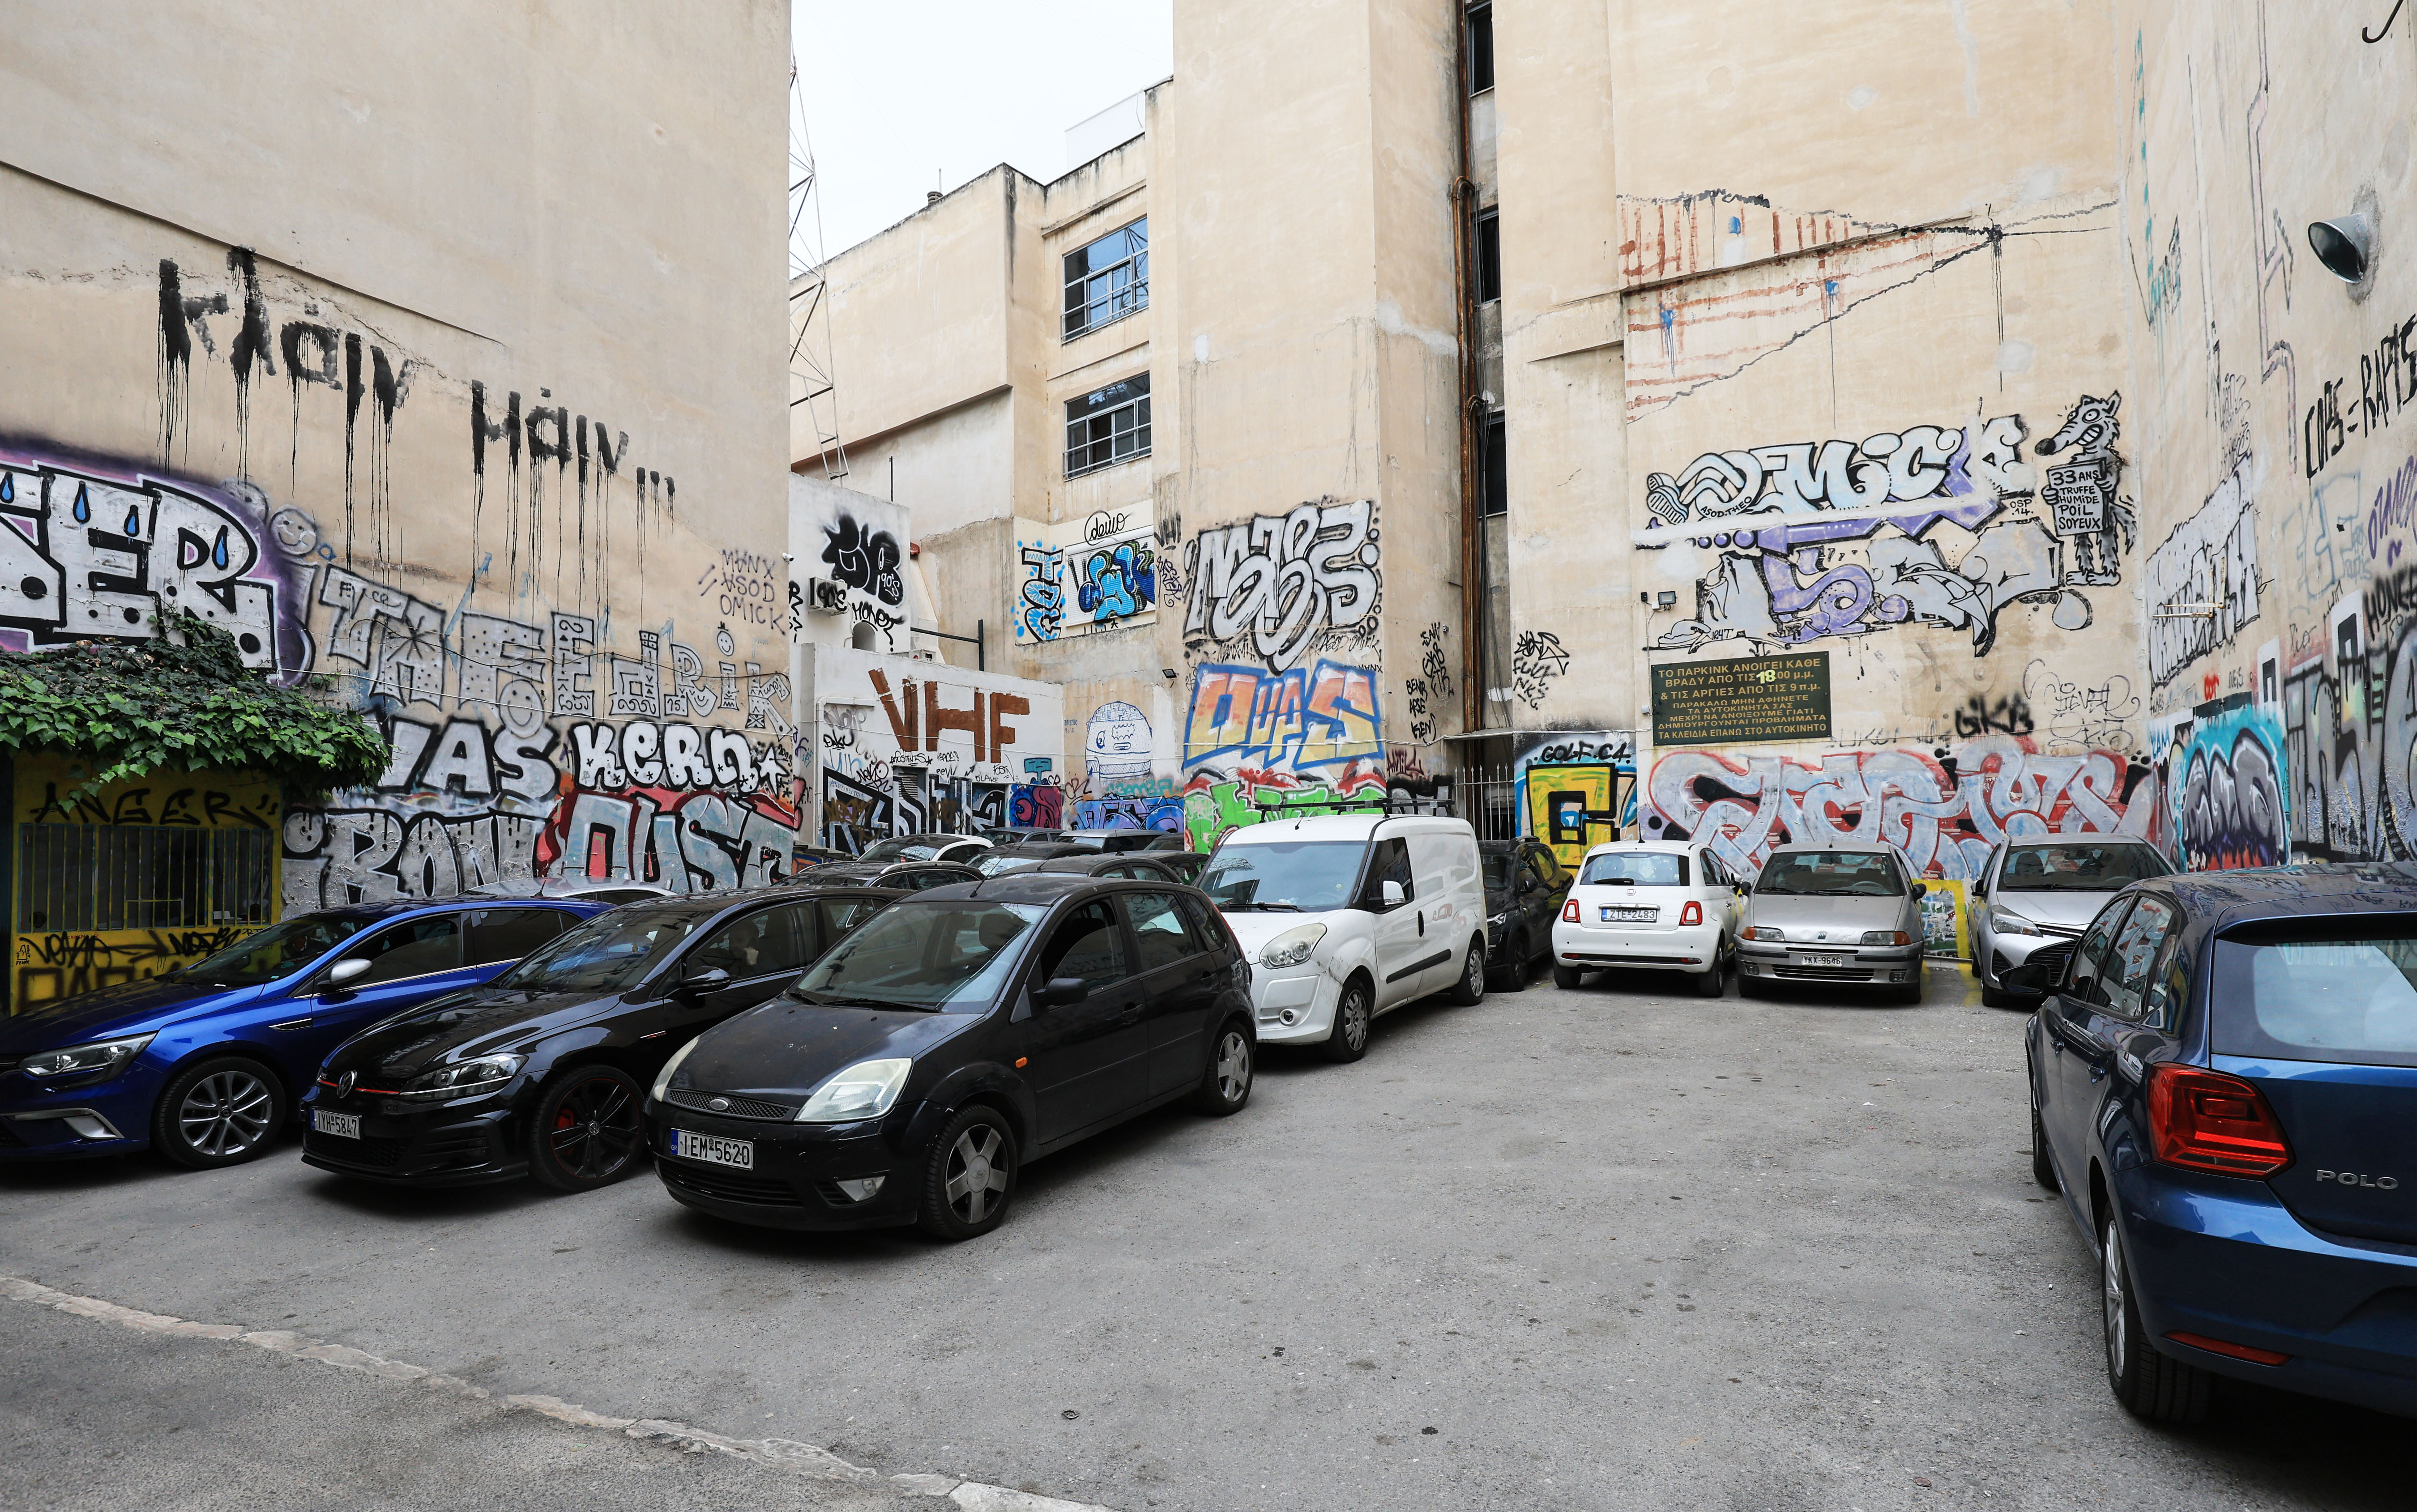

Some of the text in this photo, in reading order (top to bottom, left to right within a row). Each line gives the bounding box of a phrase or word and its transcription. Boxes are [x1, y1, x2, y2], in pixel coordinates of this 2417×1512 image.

[2051, 470, 2099, 486] 33 ANS
[2059, 486, 2095, 495] TRUFFE
[2010, 499, 2032, 508] OSP
[2059, 517, 2101, 530] SOYEUX
[721, 594, 786, 635] OMICK
[1678, 665, 1729, 676] ΠΑΡΚΙΝΚ
[1733, 661, 1782, 672] ΑΝΟΙΓΕΙ
[1786, 658, 1820, 668] ΚΑΘΕ
[1665, 677, 1704, 687] ΒΡΑΔΥ
[1708, 675, 1733, 684] ΑΠΟ
[1737, 673, 1755, 681] ΤΙΣ
[1670, 691, 1688, 699] ΤΙΣ
[1692, 688, 1734, 698] ΑΡΓΙΕΣ
[1738, 686, 1764, 694] ΑΠΟ
[1767, 684, 1786, 692] ΤΙΣ
[1673, 700, 1728, 708] ΠΑΡΑΚΑΛΩ
[1759, 694, 1809, 703] ΑΦΗΝΕΤΕ
[868, 667, 1030, 763] VHF
[1704, 704, 1769, 713] ΑΥΤΟΚΙΝΗΤΑ
[1721, 710, 1783, 719] ΑΝΟΙΞΟΥΜΕ
[1658, 715, 1826, 729] ΔΗΜΙΟΥΡΓΟΥΝΤΑΙ ΠΡΟΒΛΗΜΑΤΑ
[1672, 730, 1708, 738] ΚΛΕΙΔΙΑ
[1710, 728, 1742, 737] ΕΠΑΝΩ
[1765, 724, 1826, 733] ΑΥΤΟΚΙΝΗΤΟ
[2316, 1169, 2399, 1190] POLO
